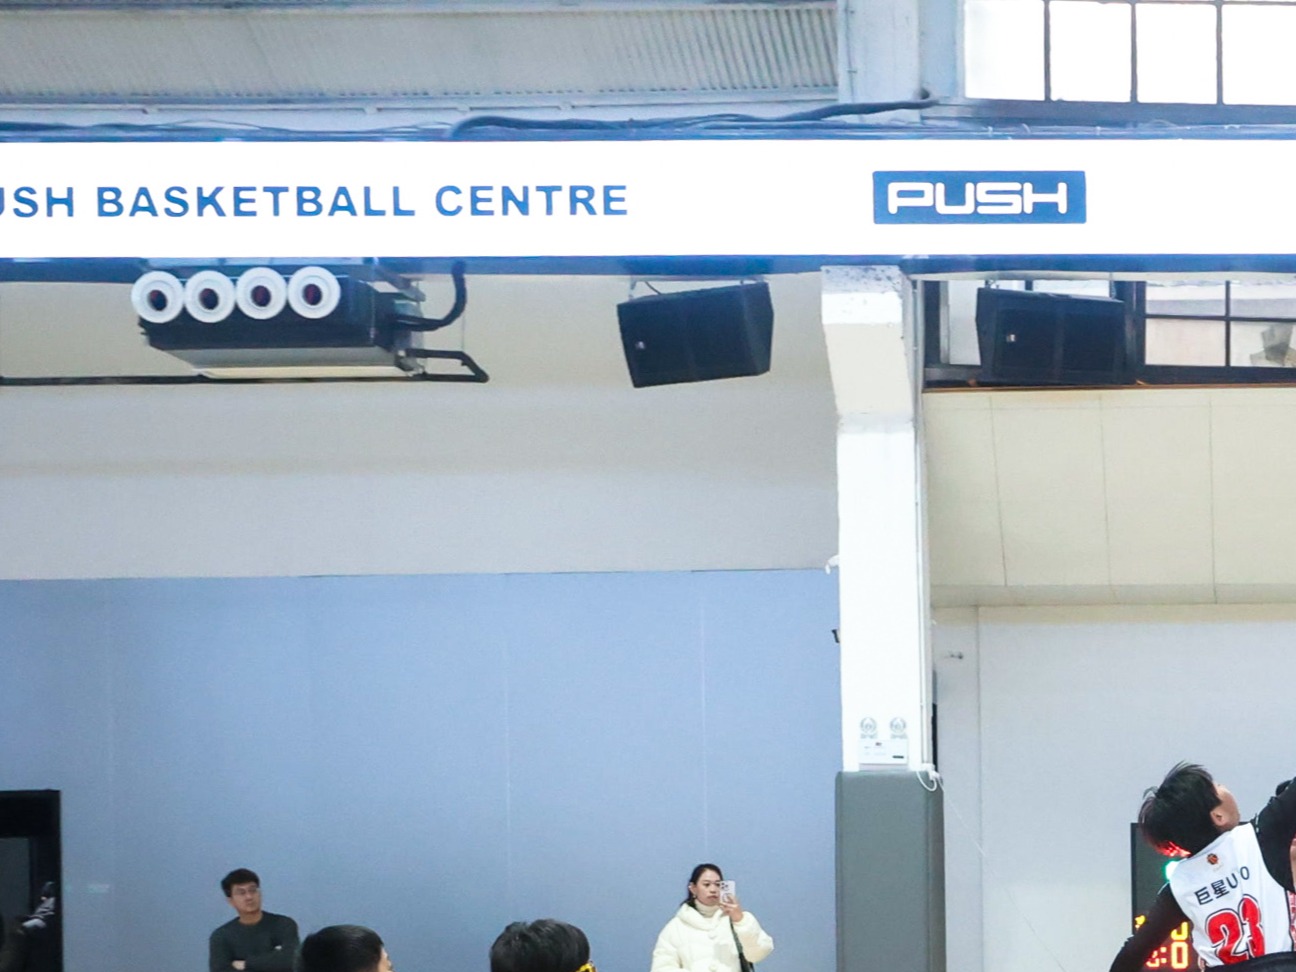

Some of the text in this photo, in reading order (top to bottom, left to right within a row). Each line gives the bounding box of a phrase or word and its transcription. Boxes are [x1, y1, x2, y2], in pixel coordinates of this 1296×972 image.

[0, 185, 628, 217] SH BASKETBALL CENTRE
[887, 181, 1068, 215] PUSH
